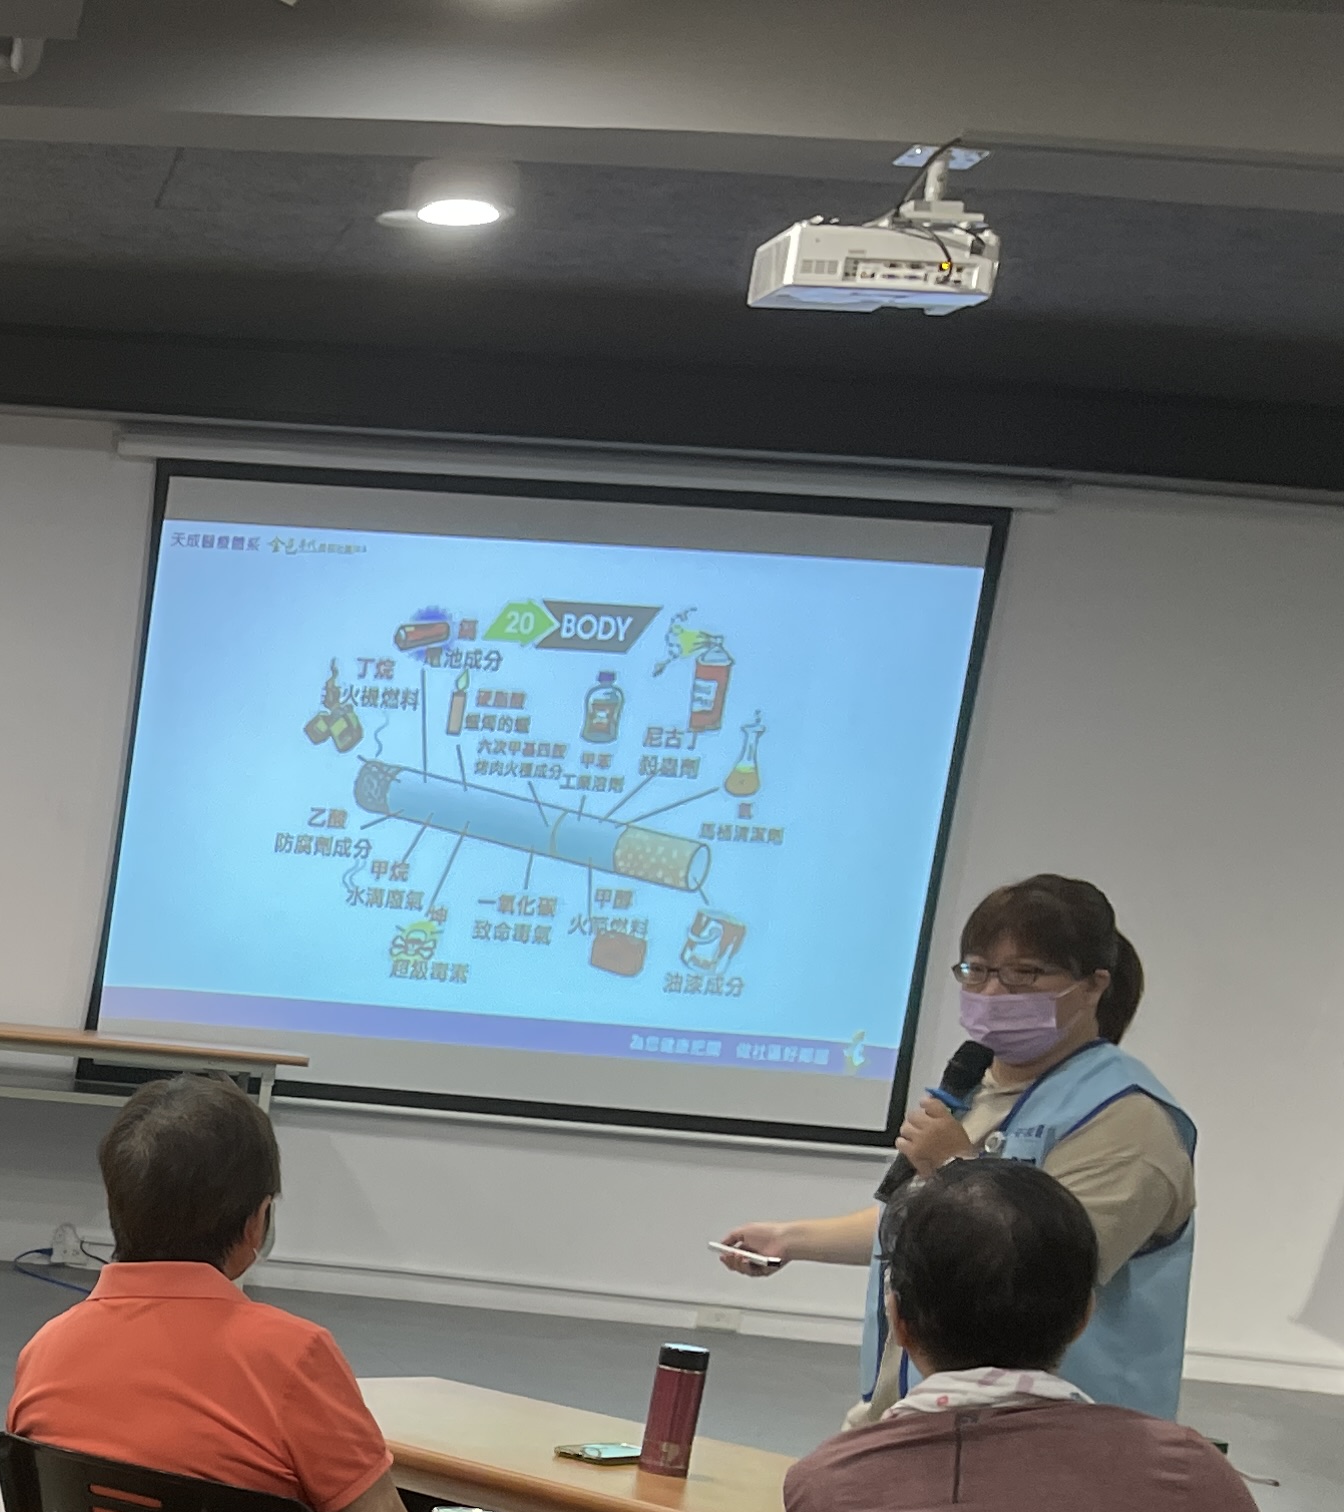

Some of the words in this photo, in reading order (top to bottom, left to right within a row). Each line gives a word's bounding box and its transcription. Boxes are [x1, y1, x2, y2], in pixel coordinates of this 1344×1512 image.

[506, 611, 535, 635] 20
[561, 613, 633, 641] BODY
[370, 860, 409, 882] 甲烷
[663, 972, 744, 997] 油漆成分
